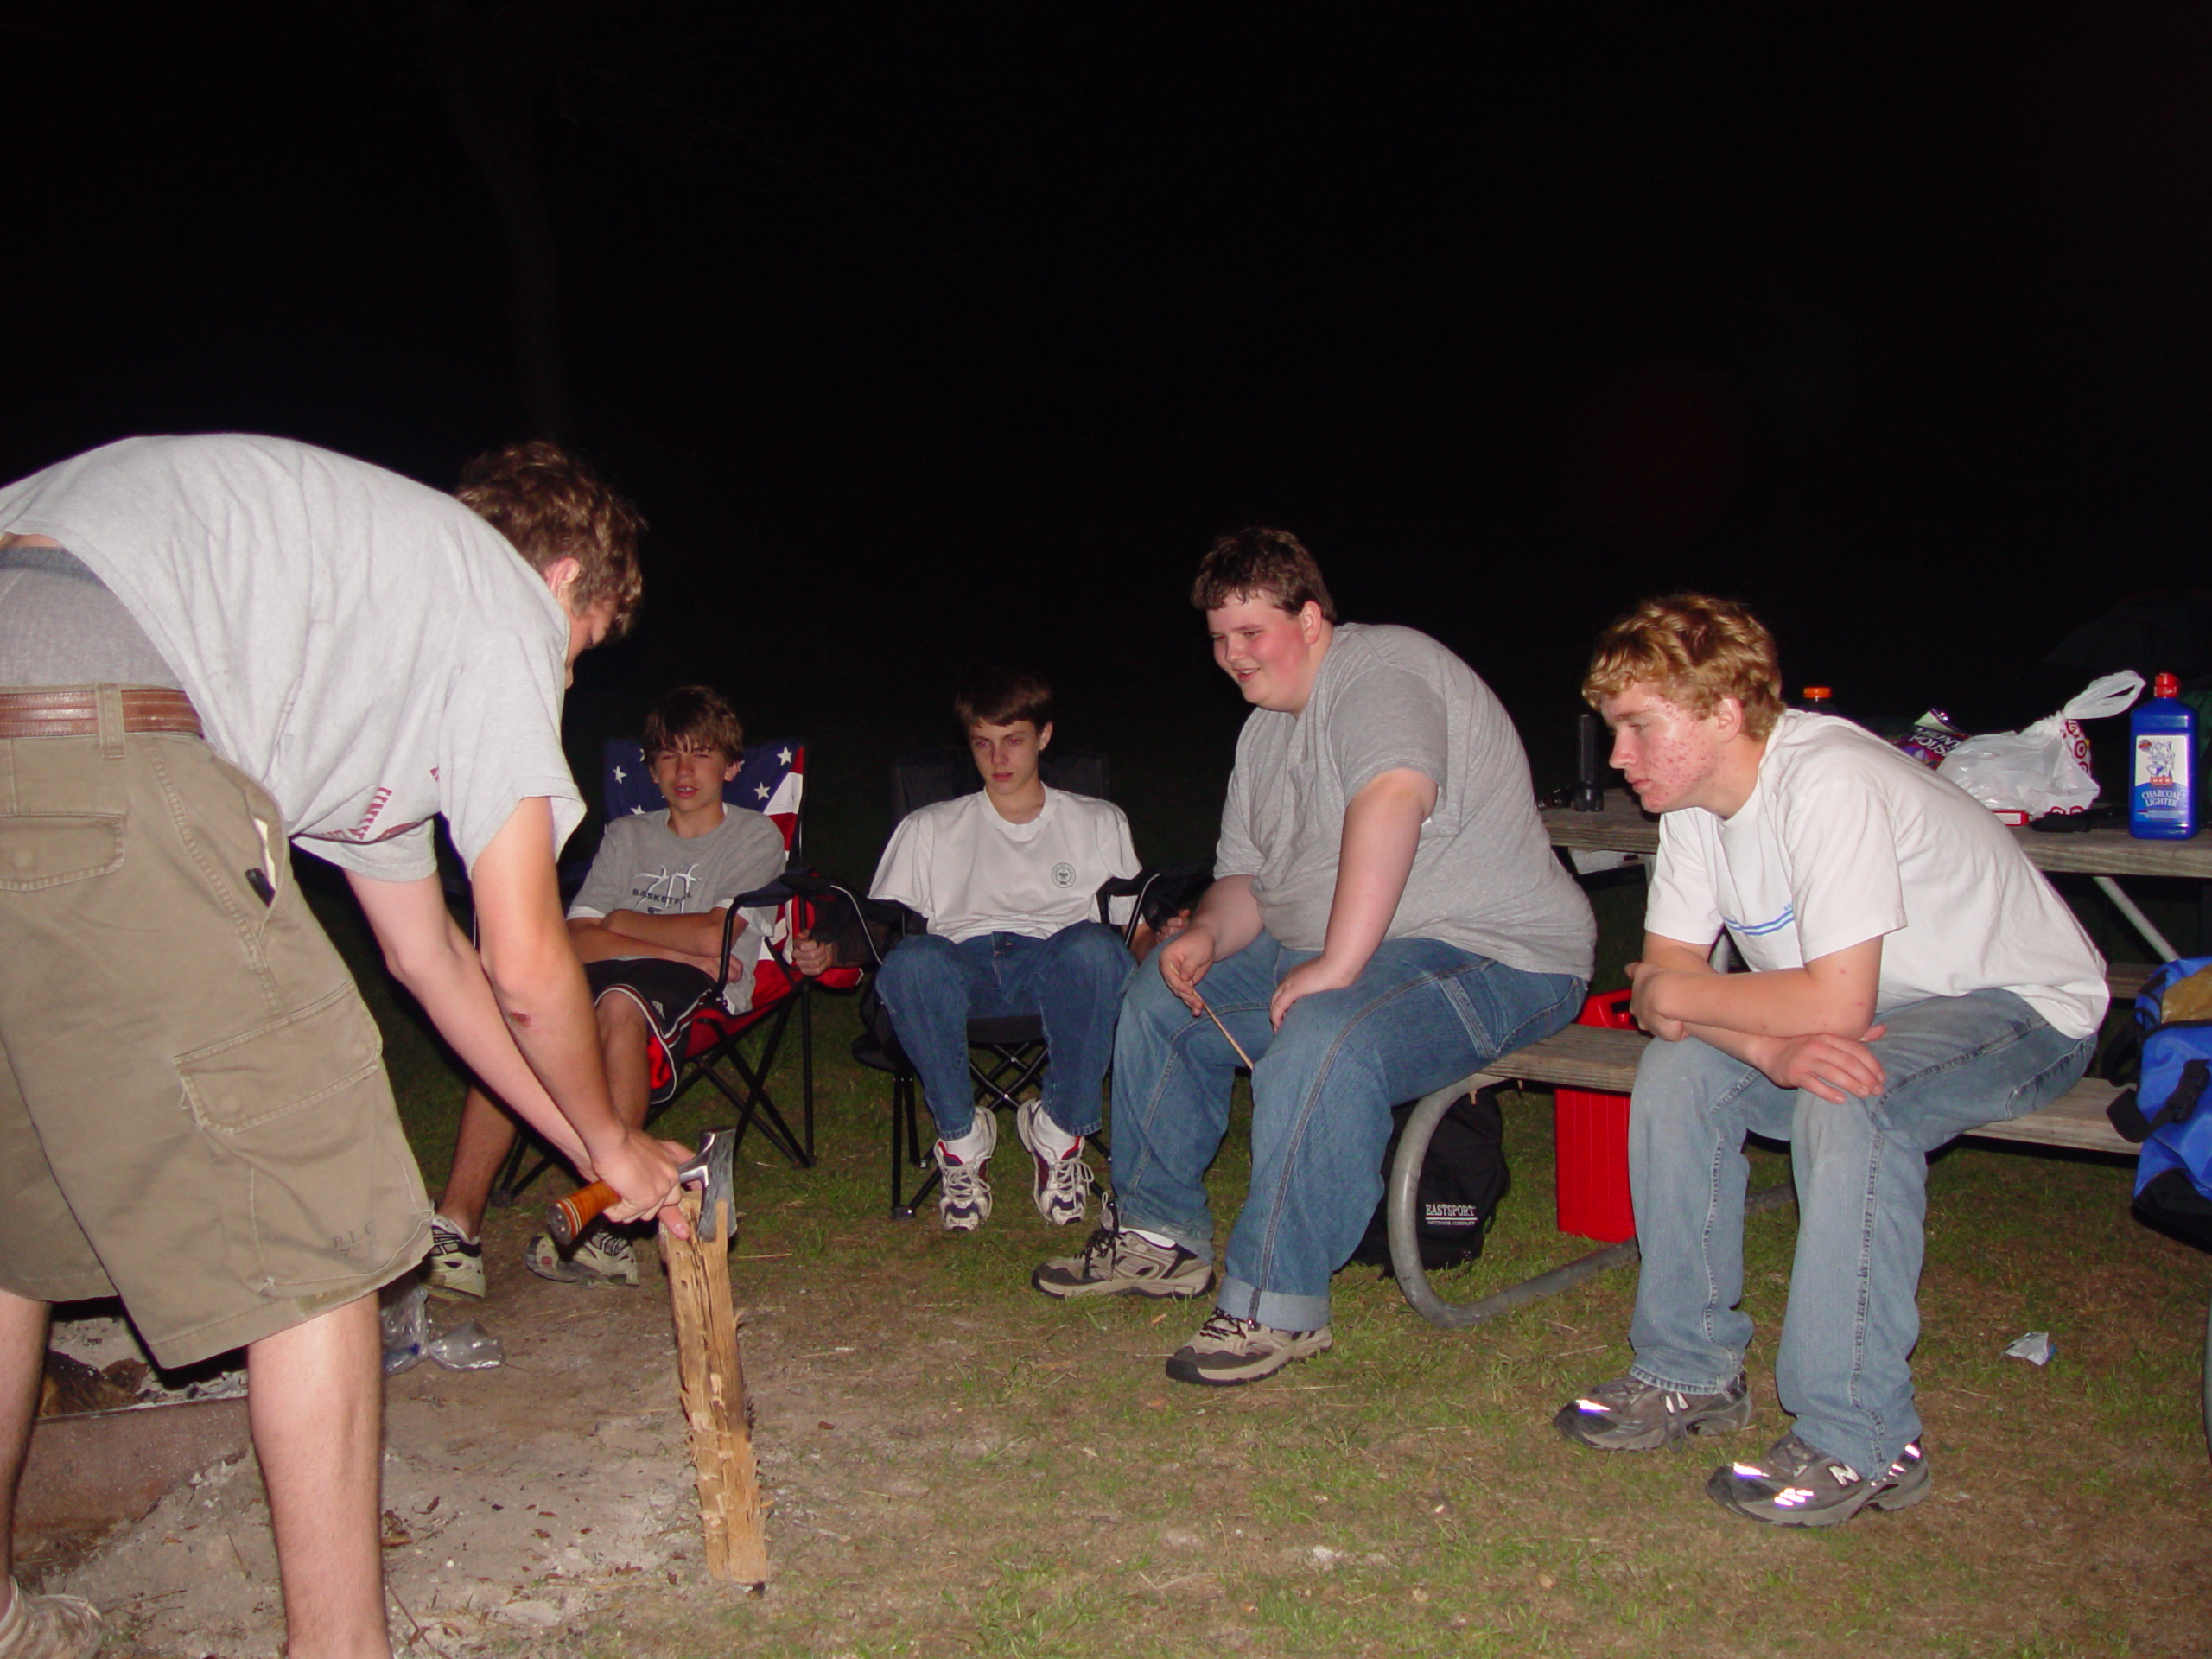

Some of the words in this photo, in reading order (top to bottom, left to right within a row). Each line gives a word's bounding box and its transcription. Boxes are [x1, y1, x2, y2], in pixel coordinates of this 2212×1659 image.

[2141, 789, 2181, 800] CHARCOAL
[2145, 798, 2177, 808] LIGHTER
[632, 889, 691, 904] BASKETBL
[1425, 1204, 1476, 1217] EASTSPORT
